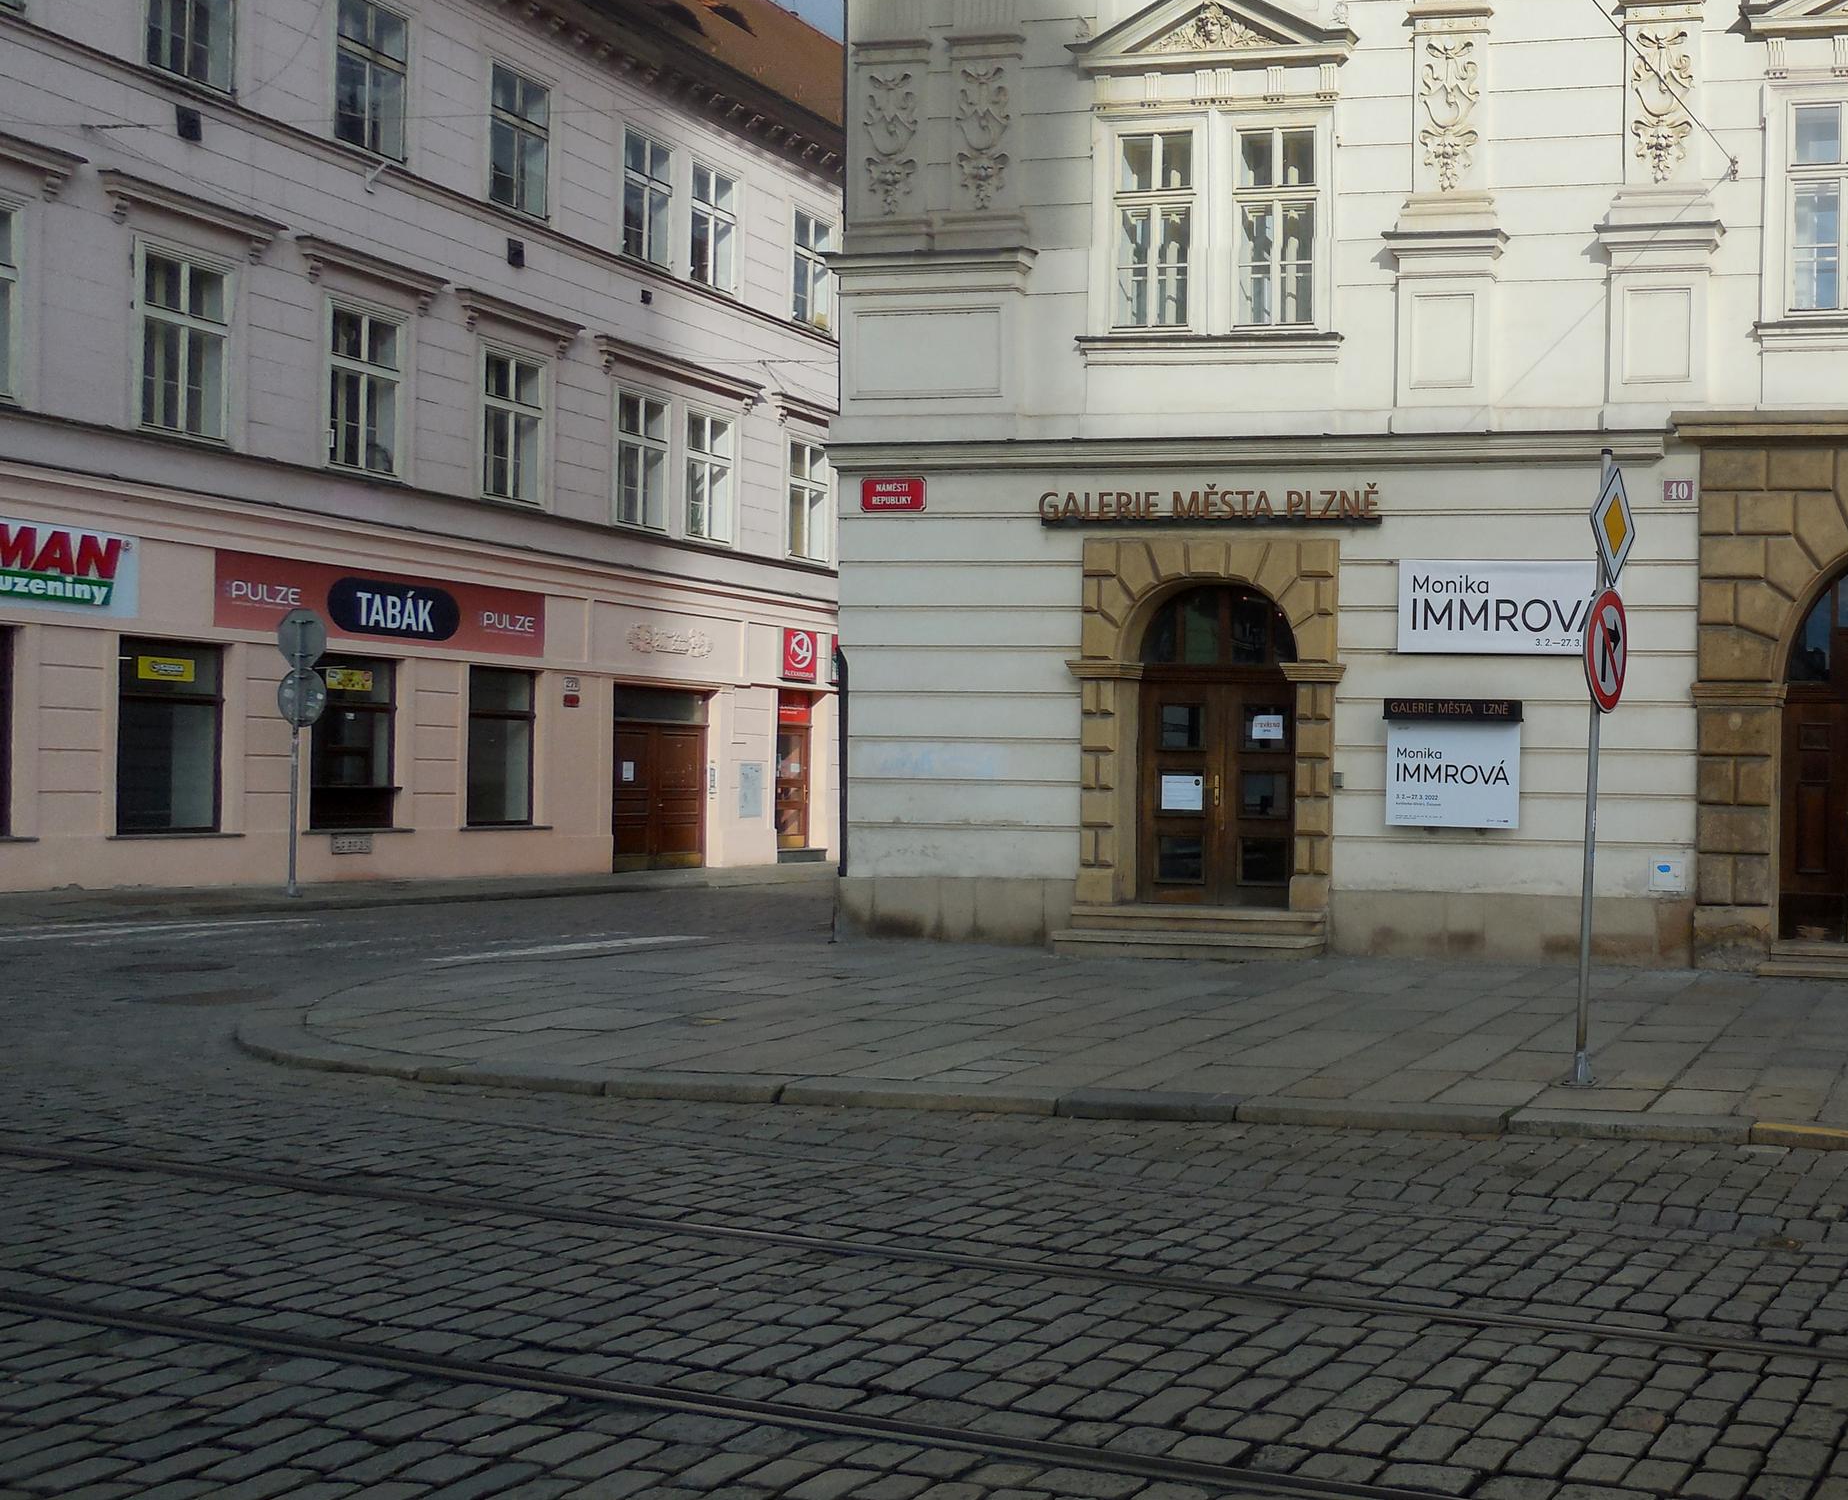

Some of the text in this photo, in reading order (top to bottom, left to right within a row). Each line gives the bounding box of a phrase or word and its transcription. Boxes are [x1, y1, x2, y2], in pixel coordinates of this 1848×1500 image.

[1667, 482, 1689, 500] 40
[871, 496, 912, 505] REPUBLIKY
[1038, 482, 1379, 520] GALERIE MĚSTA PLZNĚ
[1412, 574, 1489, 594] Monika
[232, 580, 535, 633] PULZE TABÁK PULZE
[1535, 638, 1543, 647] 3.
[1574, 639, 1582, 648] 3.
[1391, 702, 1434, 714] GALERIE
[1439, 701, 1473, 714] MĚSTA
[1396, 747, 1442, 759] Monika
[1396, 760, 1510, 786] IMMROVÁ
